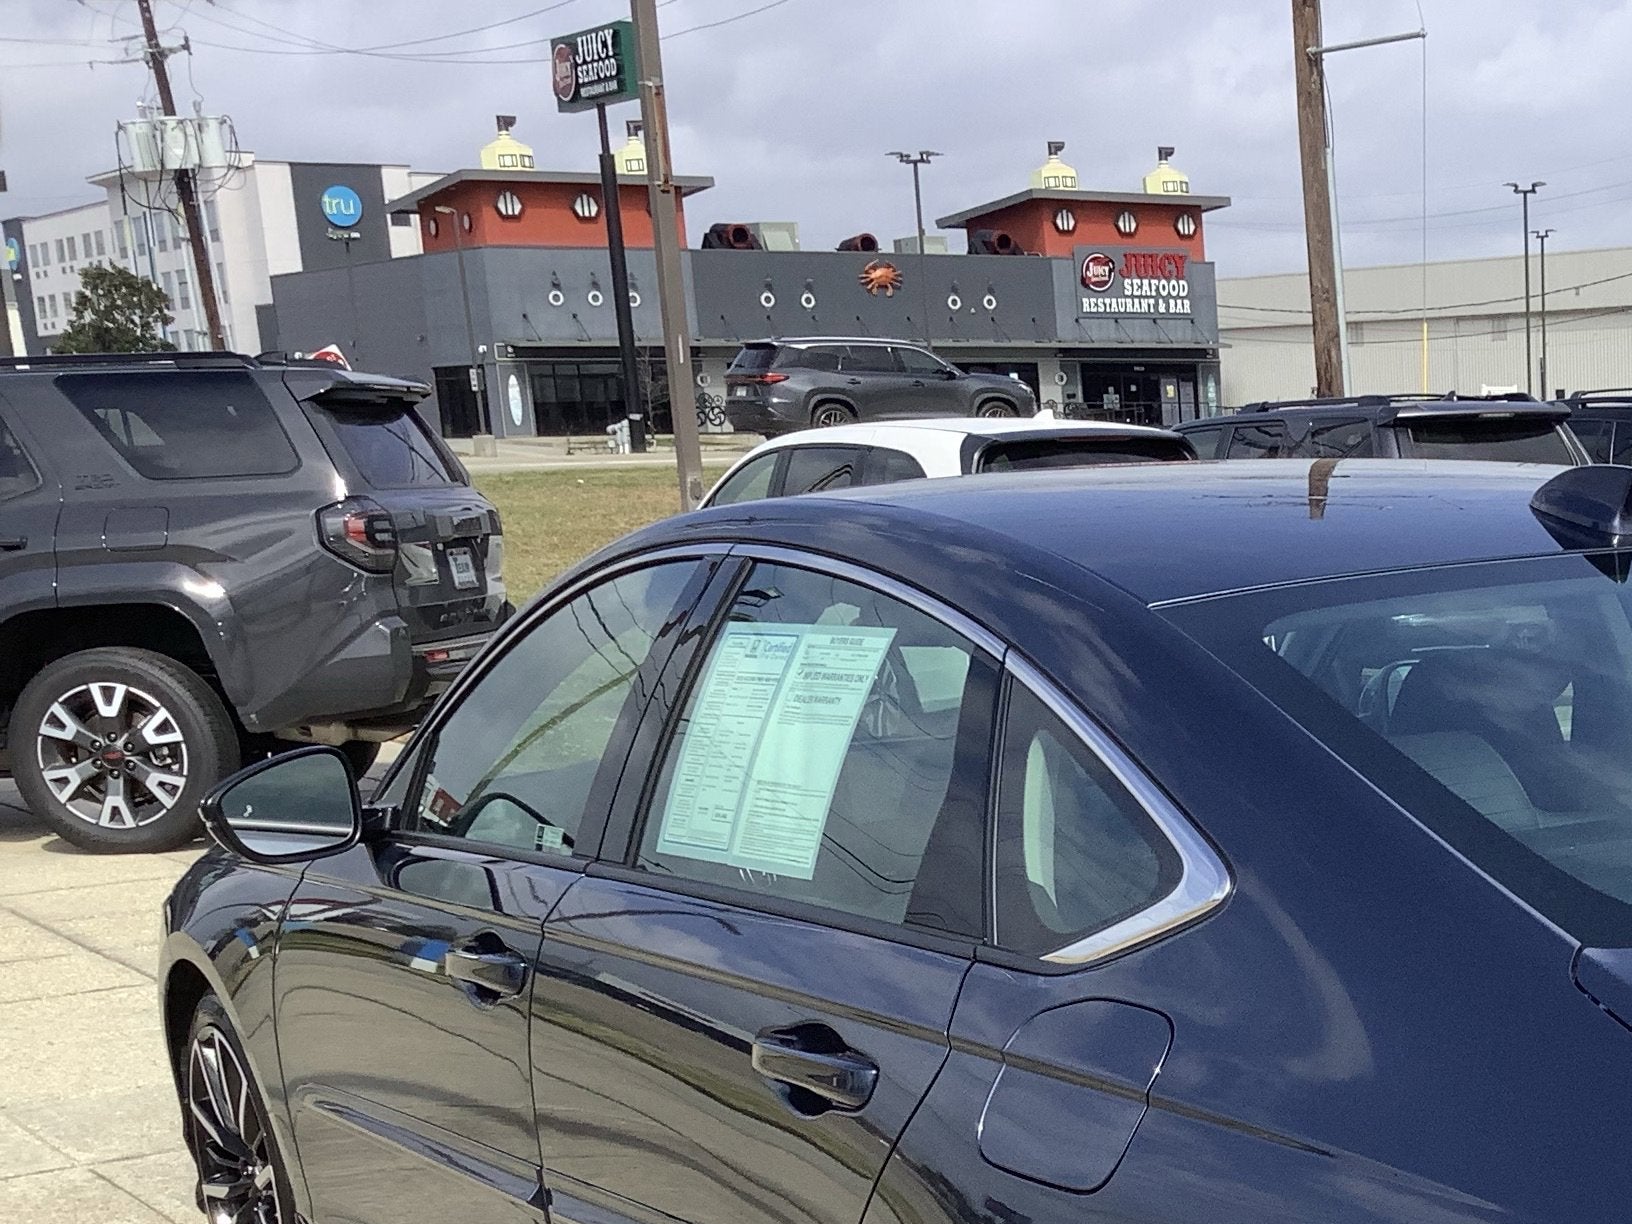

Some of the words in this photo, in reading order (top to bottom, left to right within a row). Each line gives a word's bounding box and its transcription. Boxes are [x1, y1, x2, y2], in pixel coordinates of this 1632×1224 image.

[575, 29, 614, 65] JUICY
[577, 58, 617, 84] SEAFOOD
[321, 194, 355, 215] tru
[1119, 252, 1188, 279] JUICY
[1123, 279, 1189, 297] SEAFOOD
[1082, 298, 1155, 313] RESTAURANT
[1158, 299, 1167, 313] &
[1169, 299, 1191, 314] BAR
